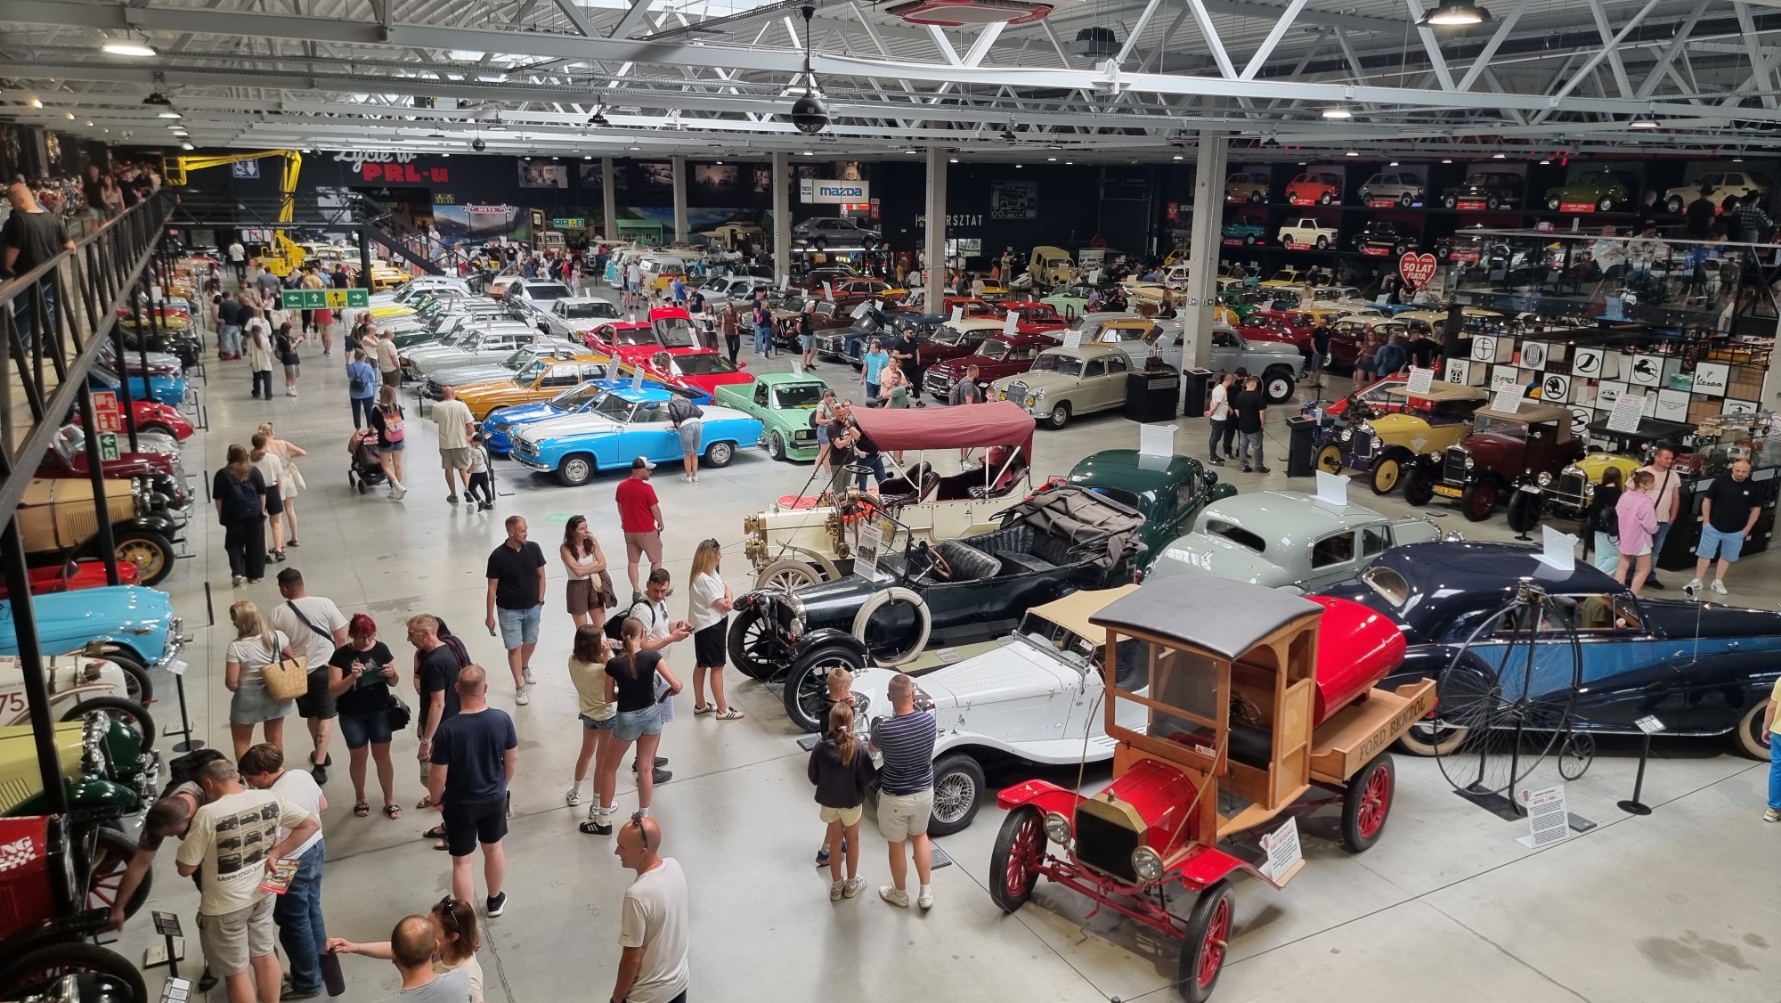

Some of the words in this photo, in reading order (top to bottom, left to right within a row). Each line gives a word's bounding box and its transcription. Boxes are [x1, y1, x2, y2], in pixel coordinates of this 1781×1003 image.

[946, 214, 983, 226] RSZTAT
[1403, 262, 1416, 272] 50
[1416, 263, 1434, 274] LAT
[1406, 272, 1426, 281] FIATA
[1359, 729, 1386, 762] FORD
[1390, 697, 1426, 737] BENZOL
